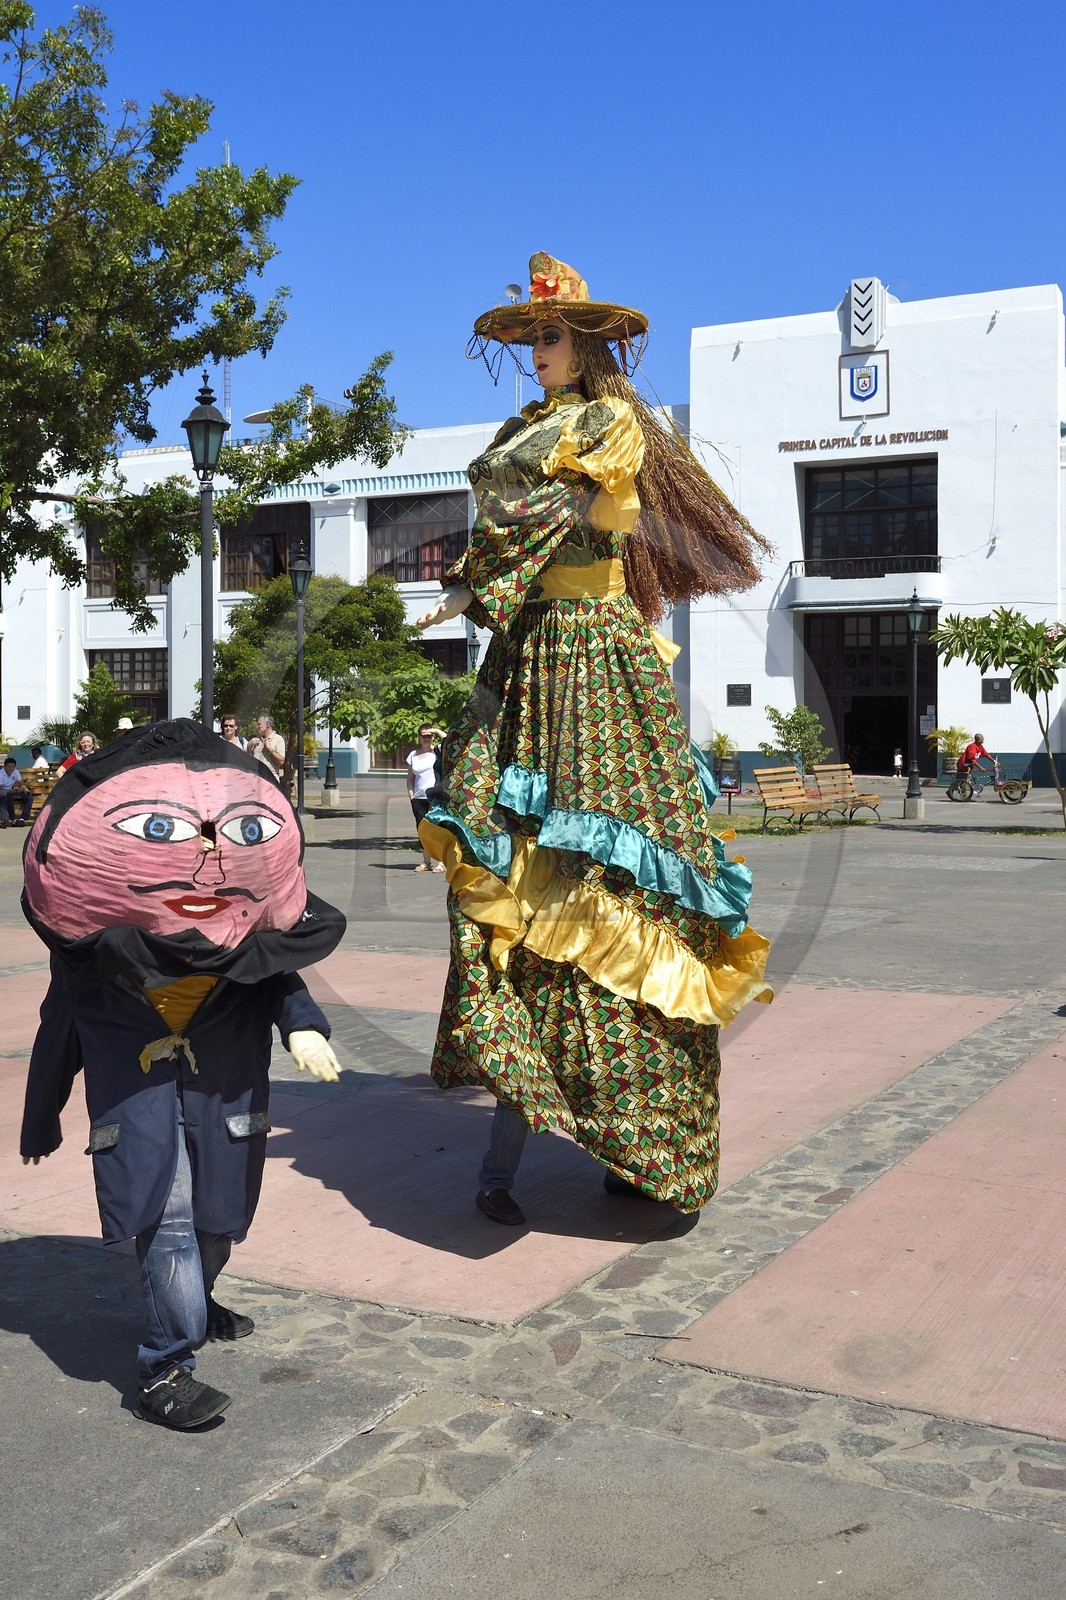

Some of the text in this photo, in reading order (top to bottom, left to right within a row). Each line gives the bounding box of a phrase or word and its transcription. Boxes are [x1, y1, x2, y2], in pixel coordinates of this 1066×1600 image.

[778, 429, 948, 452] PRIMERA CAPITAL DE LA REVOLUCION
